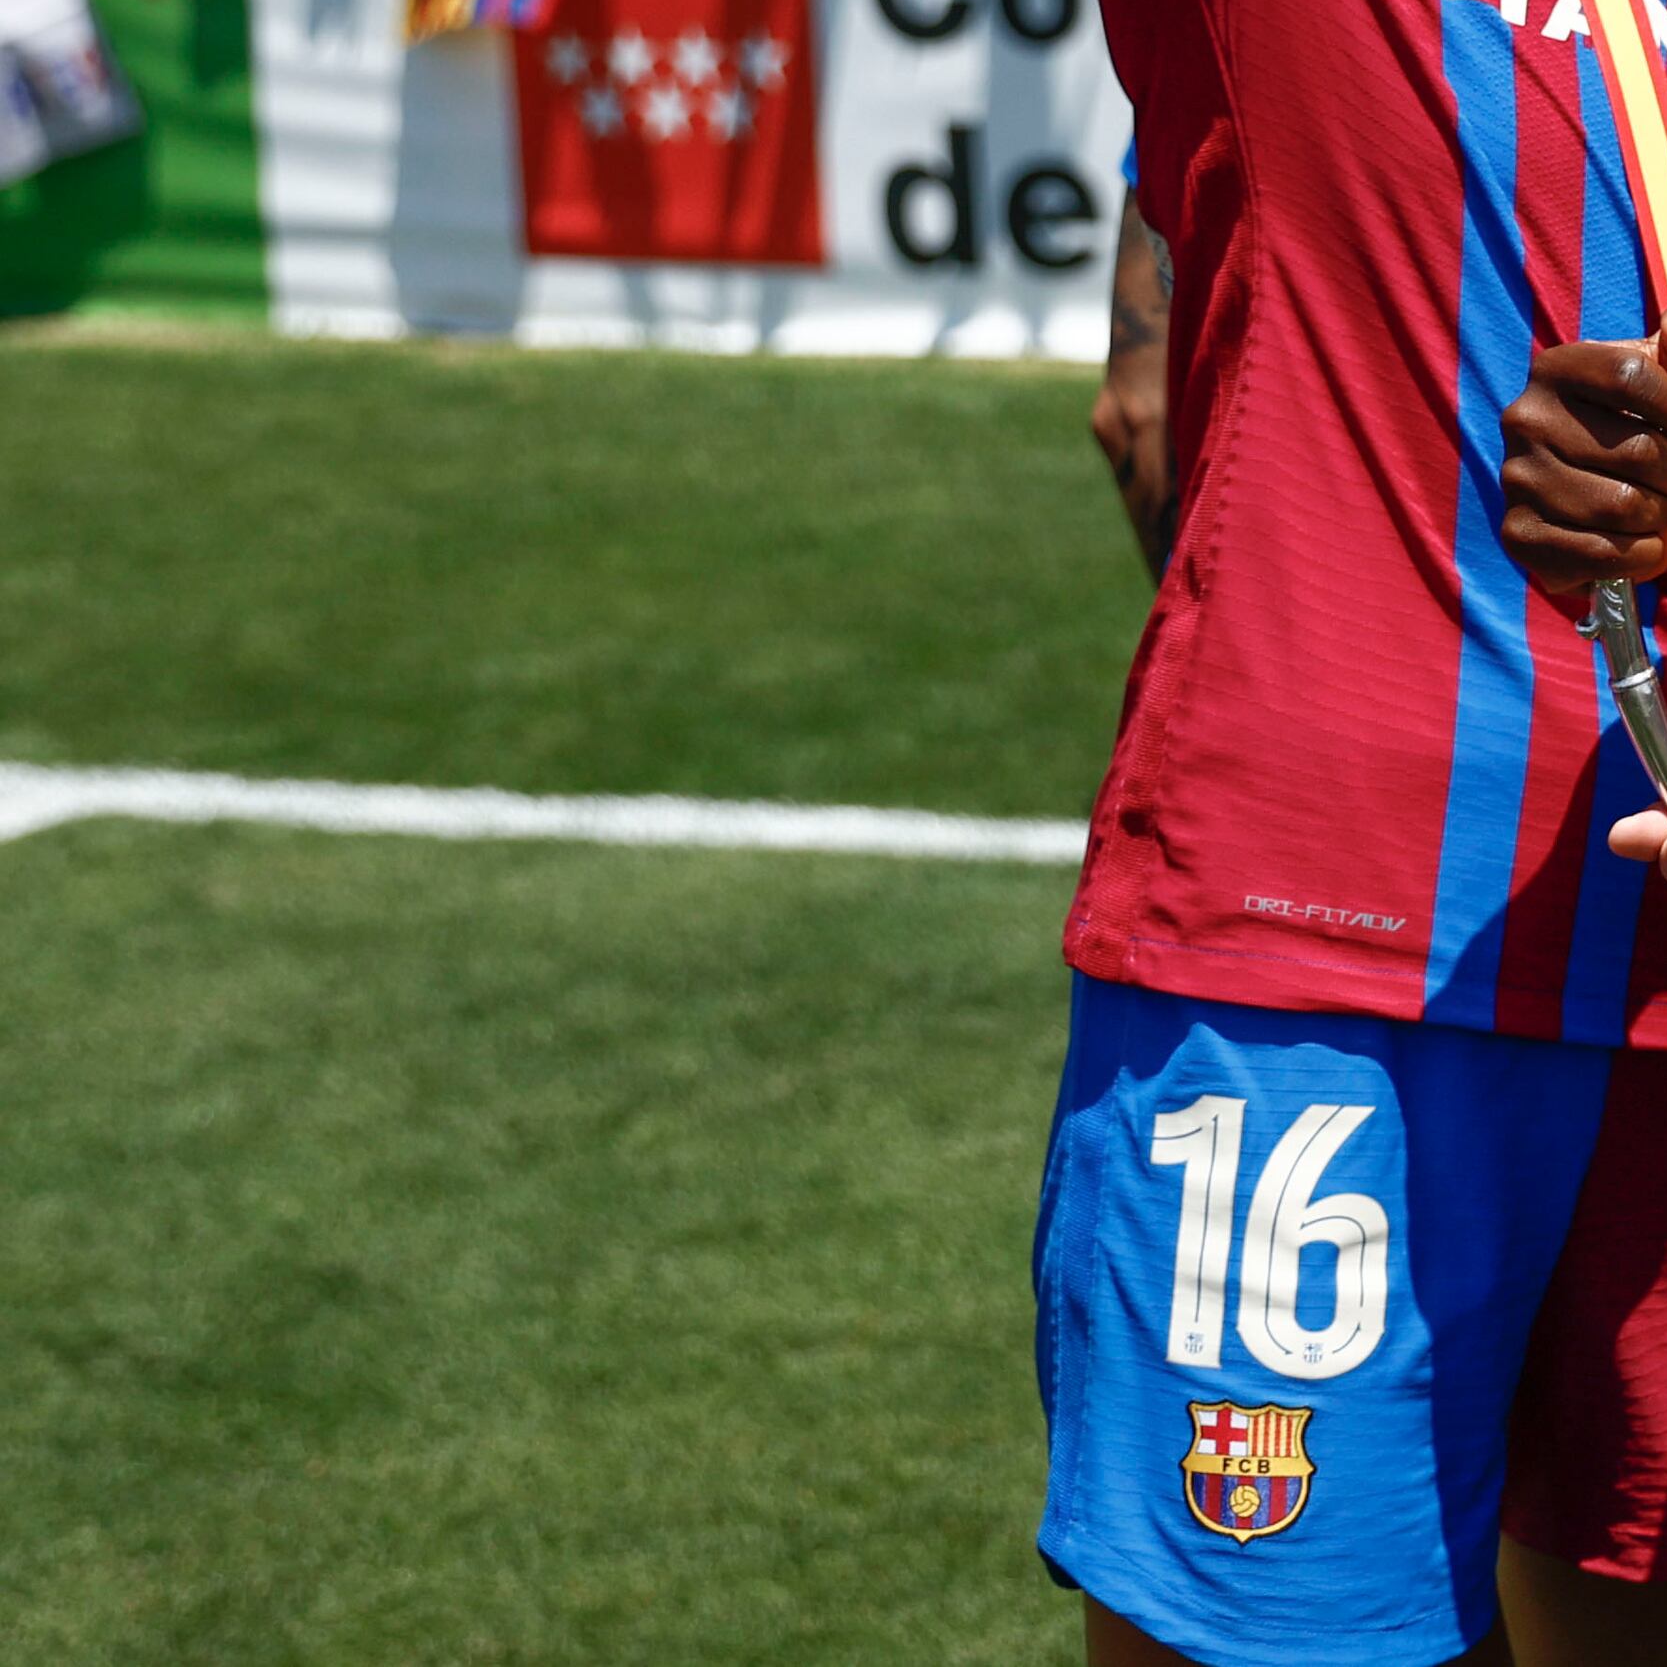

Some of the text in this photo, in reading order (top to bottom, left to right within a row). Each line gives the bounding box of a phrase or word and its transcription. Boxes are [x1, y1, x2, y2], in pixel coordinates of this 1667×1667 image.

[885, 121, 1099, 270] de
[1150, 1094, 1390, 1381] 16
[1222, 1456, 1271, 1474] FCB
